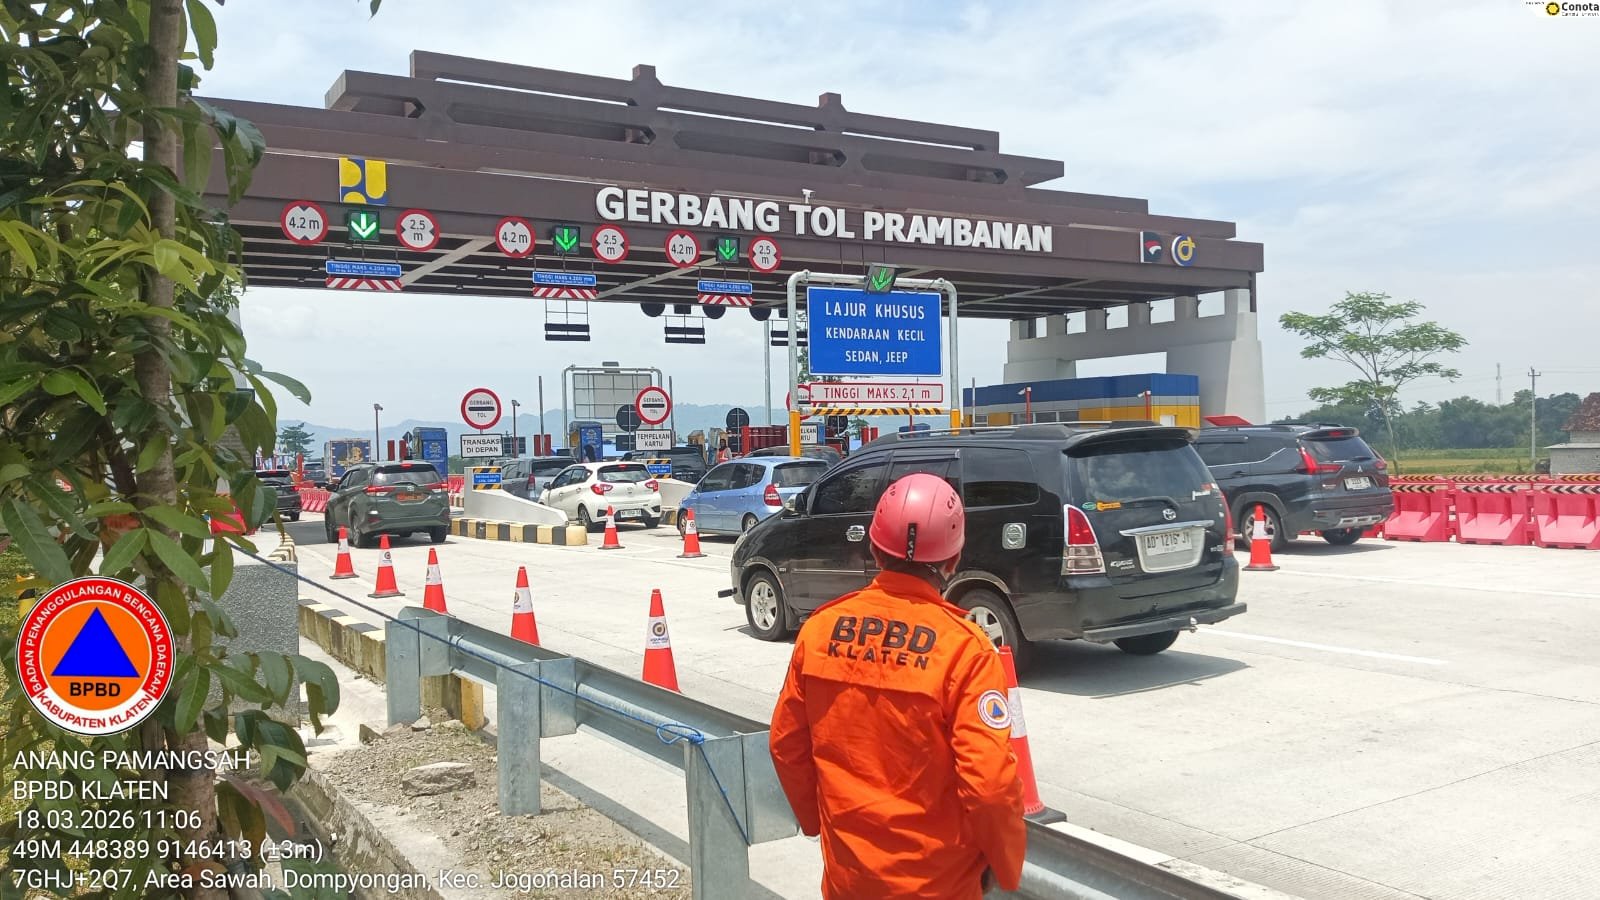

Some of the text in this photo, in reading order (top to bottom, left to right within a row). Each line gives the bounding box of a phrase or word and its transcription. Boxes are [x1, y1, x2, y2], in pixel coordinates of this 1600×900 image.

[288, 217, 320, 230] 4.2 m
[410, 220, 426, 230] 2.5
[596, 186, 1053, 252] GERBANG TOL PRAMBANAN
[413, 233, 423, 241] m
[502, 232, 528, 244] 4.2 m
[604, 235, 617, 244] 2.5
[607, 247, 616, 255] m
[671, 244, 694, 255] 4.2 m
[759, 245, 771, 254] 2.5
[825, 302, 925, 320] LAJUR KHUSUS
[826, 327, 925, 342] KENDARAAN KECIL
[845, 350, 908, 364] SEDAN, JEEP
[824, 388, 860, 399] TINGGI
[867, 388, 899, 399] MAKS.
[902, 388, 914, 400] 2,1
[921, 389, 930, 399] m
[831, 616, 936, 655] BPBD
[828, 642, 930, 670] KLATEN
